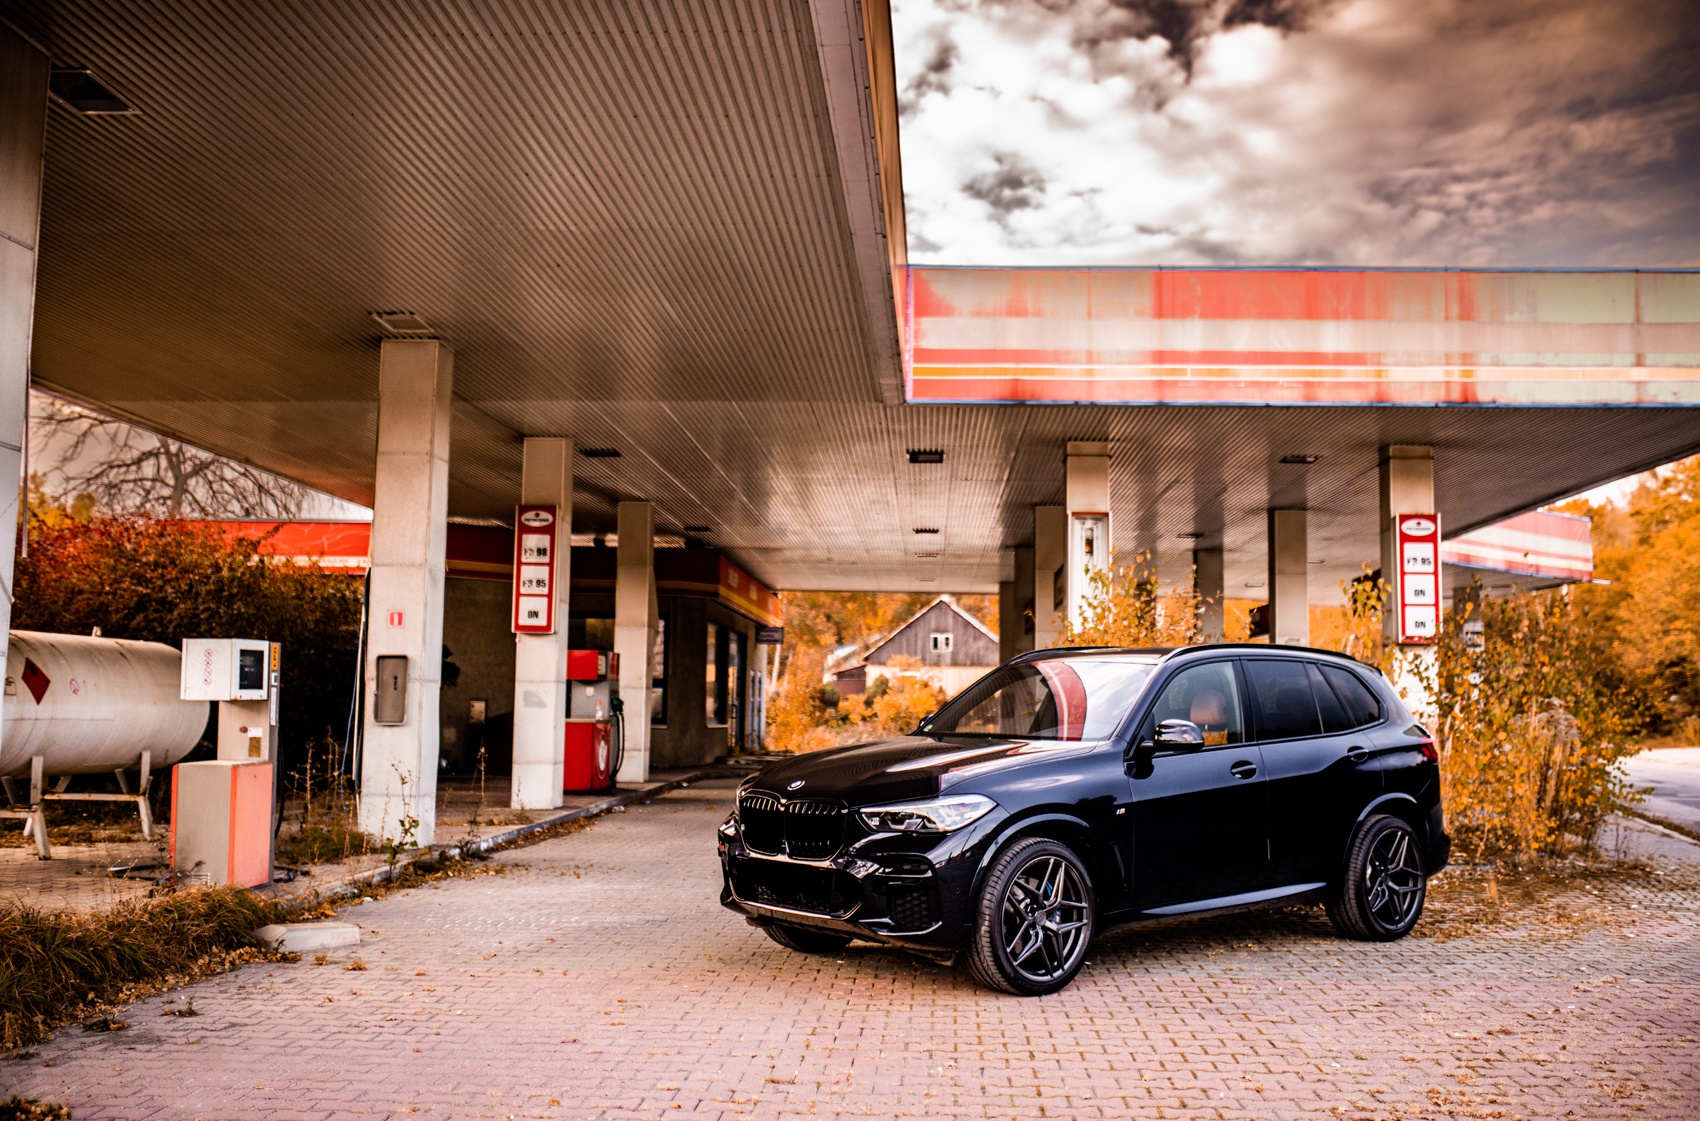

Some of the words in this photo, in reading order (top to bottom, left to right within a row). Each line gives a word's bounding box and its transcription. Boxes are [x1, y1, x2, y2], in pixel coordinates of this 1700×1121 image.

[536, 548, 548, 557] 98
[1421, 557, 1432, 566] 95
[536, 579, 547, 588] 95
[527, 610, 539, 619] ON
